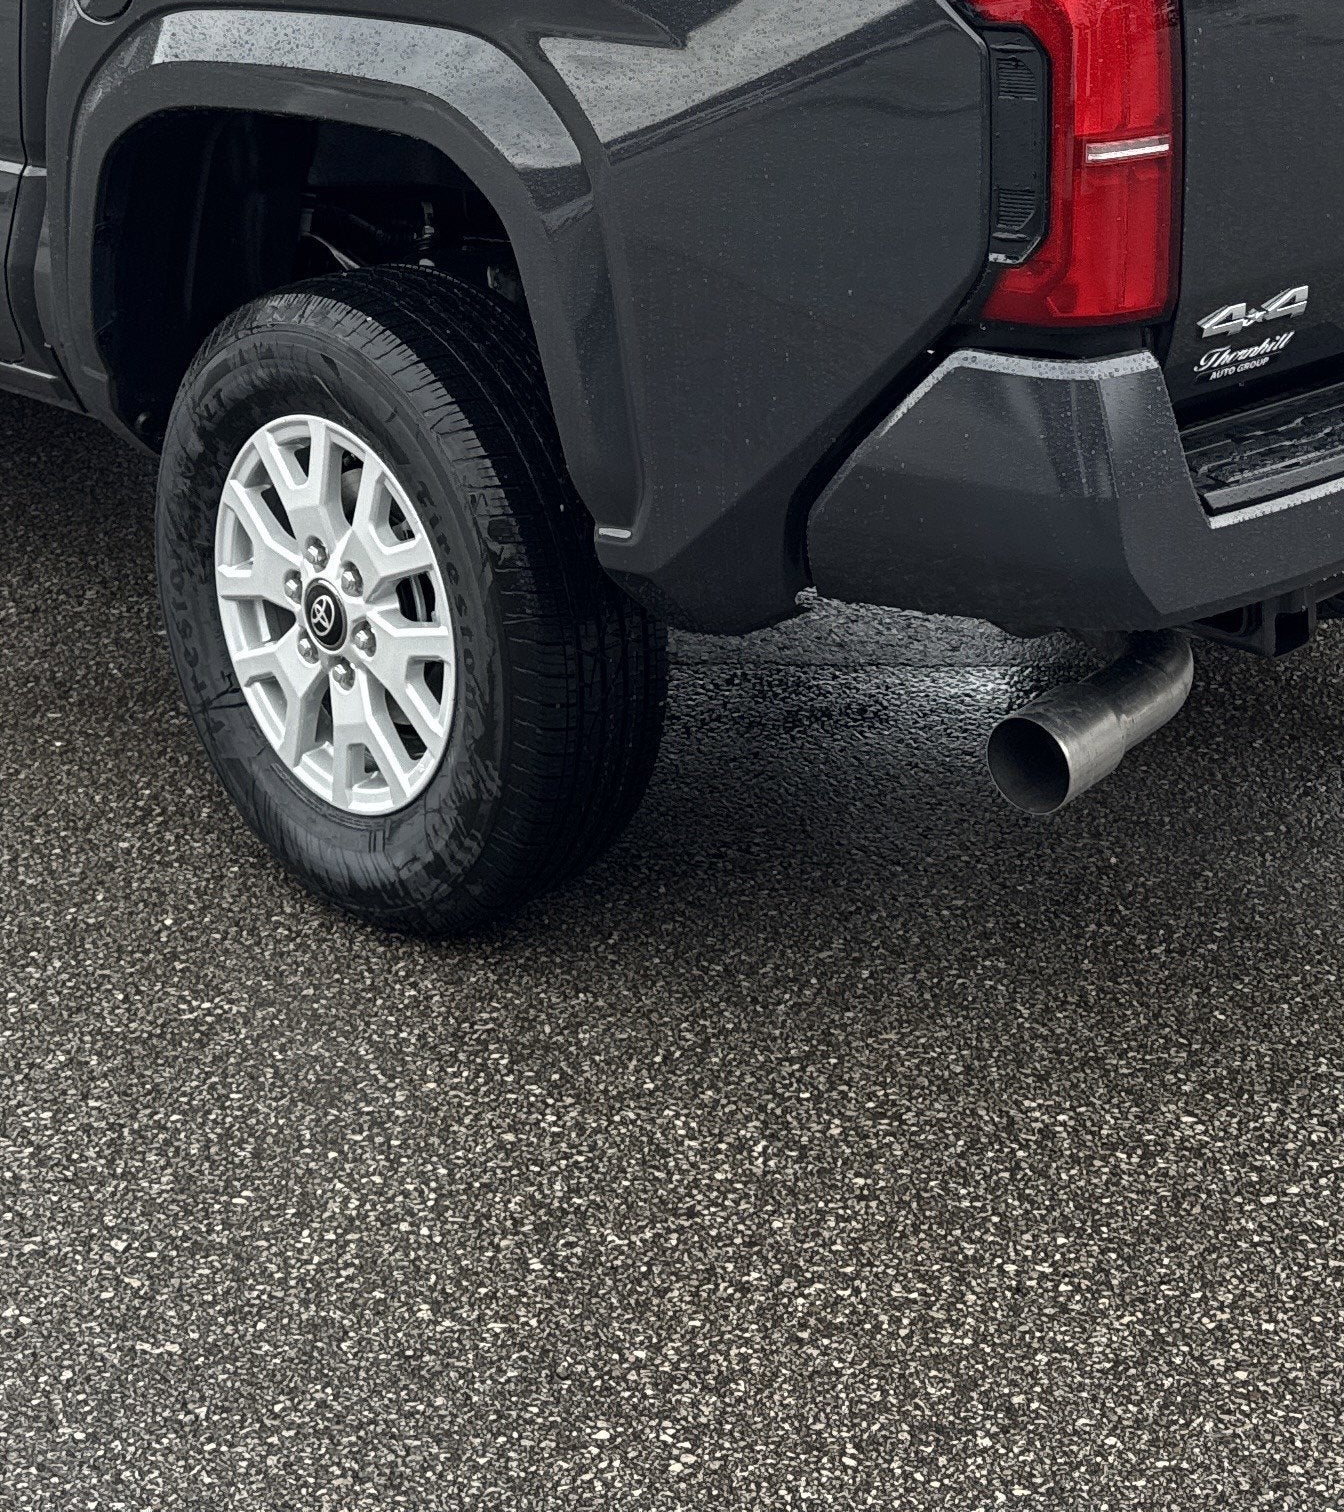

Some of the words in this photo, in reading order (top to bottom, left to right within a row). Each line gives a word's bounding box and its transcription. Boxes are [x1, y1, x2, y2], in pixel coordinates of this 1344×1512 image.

[1193, 329, 1296, 373] Thornhill
[1209, 367, 1236, 381] AUTO
[1237, 356, 1270, 373] GROUP
